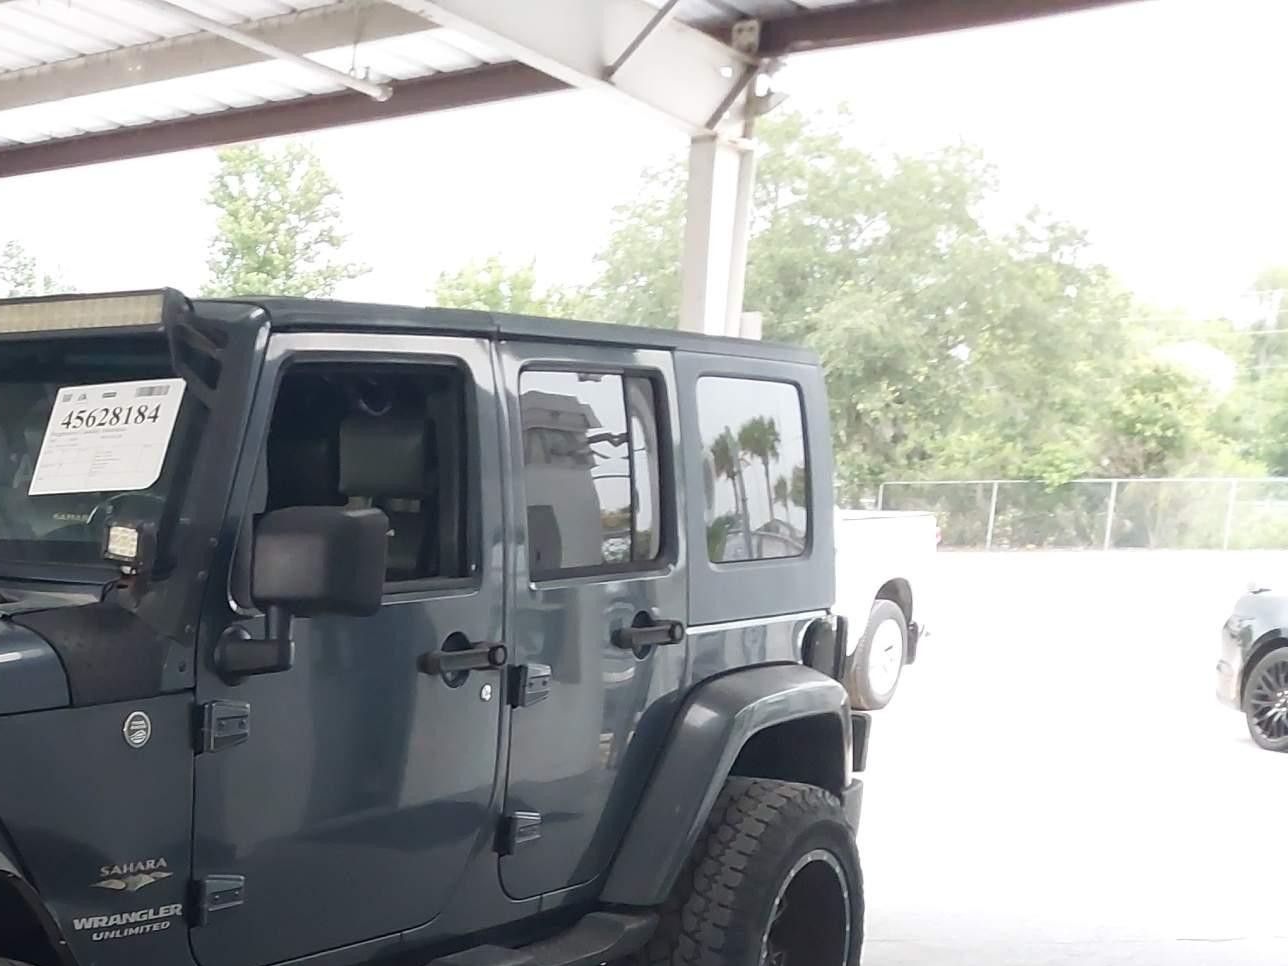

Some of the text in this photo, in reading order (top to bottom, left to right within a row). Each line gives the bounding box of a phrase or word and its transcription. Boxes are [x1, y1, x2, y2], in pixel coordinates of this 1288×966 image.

[60, 403, 161, 430] 45628184
[99, 857, 168, 877] SAHARA
[72, 903, 184, 931] WRANGLER
[92, 920, 171, 941] UNLIMITED
